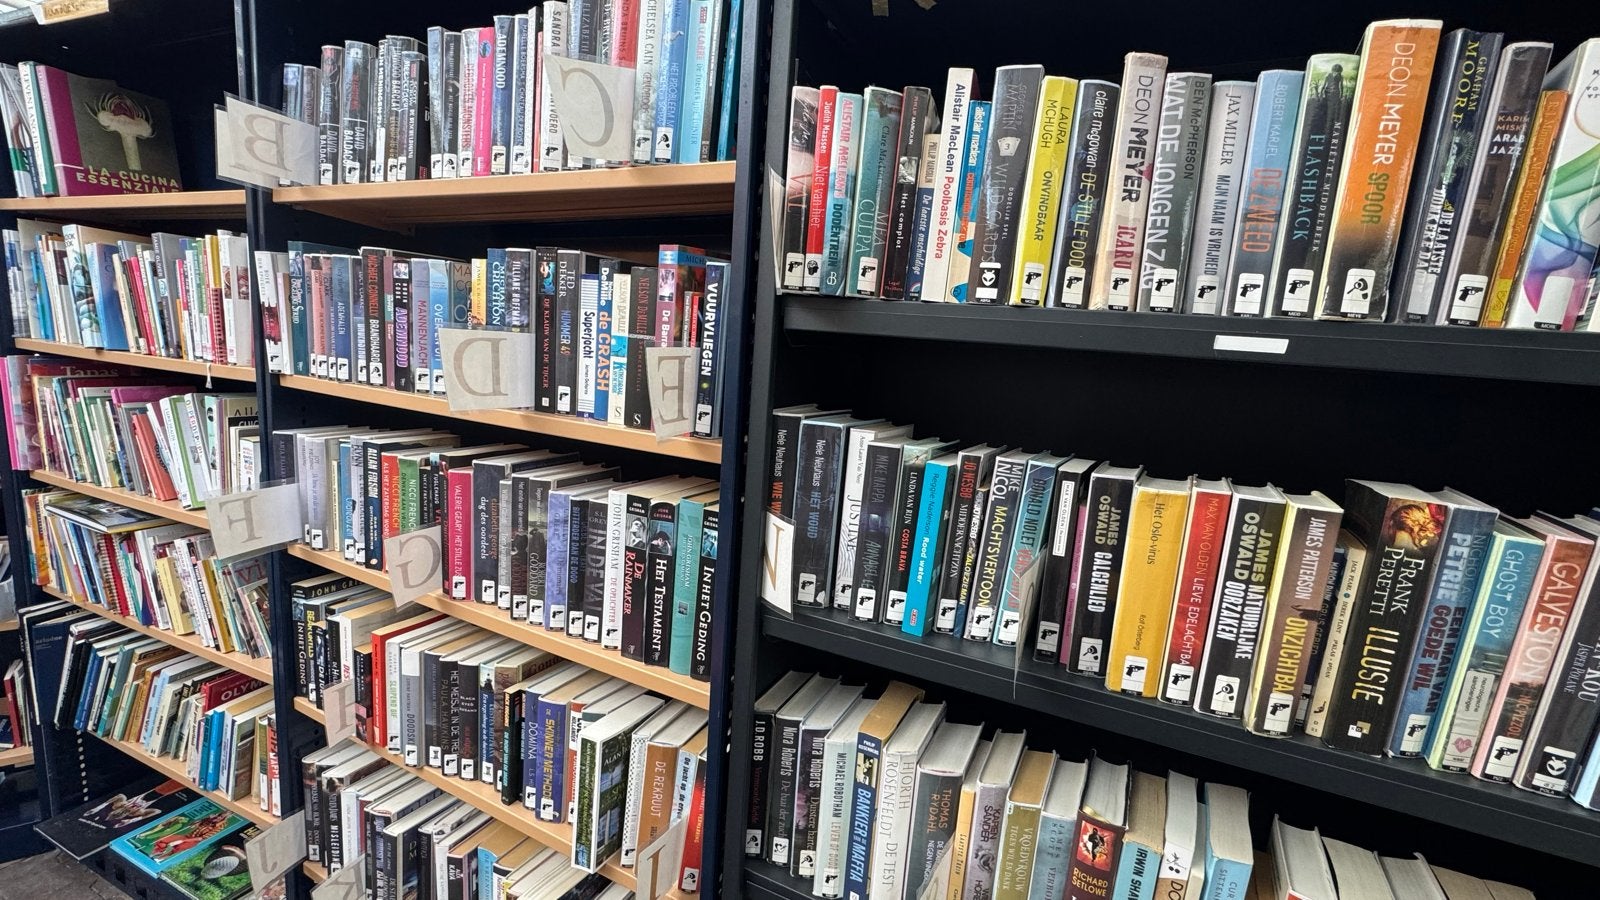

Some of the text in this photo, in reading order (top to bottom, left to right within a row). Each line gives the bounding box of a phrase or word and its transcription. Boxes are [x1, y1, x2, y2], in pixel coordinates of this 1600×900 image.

[552, 10, 561, 47] SANDRA
[496, 33, 508, 89] ADEMNOOD
[644, 43, 654, 65] CAIN
[391, 79, 400, 111] BARCLAY
[1191, 81, 1205, 107] BEN
[1451, 40, 1479, 129] MOORE
[1467, 56, 1488, 111] GRAHAM
[327, 129, 337, 153] DAVID
[354, 126, 364, 150] DAVID
[1040, 99, 1058, 149] MCHUGH
[1055, 106, 1070, 145] LAURA
[1121, 75, 1154, 204] DEON MEYER
[1360, 42, 1416, 226] DEON MEYER SPOOR
[1492, 134, 1525, 143] ARAB
[90, 165, 179, 187] LA CUCINA
[934, 83, 966, 259] Alistair MacLean Poolbasis Zebra
[1073, 91, 1107, 237] claire mcgowan STILLE
[1211, 93, 1241, 225] JAX MILLER MIJN NAAM
[1489, 146, 1523, 156] JAZZ
[816, 166, 828, 187] Niet
[1145, 127, 1181, 244] DE JONGEN
[1292, 134, 1326, 240] FLASHBACK
[1312, 121, 1342, 252] MARIETTE MIDDELBEEK
[855, 199, 875, 253] CULPA
[895, 193, 909, 249] Het complot
[1033, 170, 1053, 242] ONVINDBAAR
[827, 203, 843, 267] DODENTREIN
[367, 254, 378, 317] MICHAEL CONNELLY
[492, 262, 500, 325] CRICHTON
[559, 262, 567, 298] DEKKER
[567, 270, 575, 289] TED
[417, 300, 428, 368] MANNENJACHT
[561, 309, 571, 344] NUMMER
[581, 311, 595, 359] Superjacht
[662, 310, 670, 321] De
[701, 282, 718, 376] VUURVLIEGEN
[370, 319, 380, 363] BRANDHAARD
[597, 312, 612, 391] de CRASH
[368, 447, 378, 498] ALLAN FOLSOM
[774, 429, 787, 477] Nele Neuhaus
[454, 484, 462, 509] VALERIE
[479, 496, 489, 510] dag
[806, 439, 826, 540] Nele Neuhaus HET WOUD
[871, 454, 889, 504] MIKE NAPPA
[991, 461, 1011, 502] NICOL
[1007, 464, 1024, 493] MIKE
[1025, 478, 1046, 518] DONALD
[392, 498, 400, 528] FRENCH
[454, 511, 462, 530] GEARY
[898, 472, 918, 572] LINDA COSTA BRAVA
[917, 473, 940, 584] Reggie Rood water
[1020, 519, 1040, 548] NOLET
[1095, 495, 1111, 545] OSWALD
[1106, 506, 1122, 546] JAMES
[1147, 503, 1166, 565] Het Oslo-virus
[454, 547, 462, 565] STILLE
[480, 526, 489, 559] oordeels
[608, 503, 622, 624] JOHN GRISHAM DE OPLICHTER
[977, 505, 1008, 608] MACHTSVERTOON
[1190, 497, 1220, 604] MAX OLDEN LIEVE
[1234, 512, 1260, 581] OSWALD
[1249, 529, 1273, 583] JAMES
[1294, 517, 1328, 601] JAMES PATTERSON
[1436, 532, 1472, 601] PETRIE
[311, 584, 337, 598] JOHN
[529, 552, 539, 596] GODDARD
[623, 550, 636, 615] RAINMAKER
[634, 561, 645, 580] DE
[1088, 551, 1113, 613] GALGENLIED
[1369, 546, 1405, 616] PERETTI
[1389, 556, 1426, 616] FRANK
[1482, 549, 1524, 640] GHOST BOY
[652, 559, 668, 651] HET TESTAMENT
[1216, 580, 1246, 642] OORZAKEN
[1234, 584, 1266, 660] NATUURLIJKE
[1522, 561, 1581, 681] GALVESTON
[697, 612, 712, 661] GEDING
[1410, 604, 1451, 691] GOEDE WIL
[299, 651, 307, 684] GEDING
[1351, 626, 1400, 705] ILLUSIE
[440, 679, 449, 750] PAULA HAWKINS
[450, 670, 459, 714] HET MEISJE
[528, 721, 538, 760] DOMINA
[544, 719, 555, 758] SKINNER
[684, 757, 691, 766] De
[753, 737, 764, 761] ROBB
[780, 726, 798, 776] Nora Roberts
[650, 761, 666, 817] DE REKRUUT
[832, 752, 847, 818] MICHAEL ROBOTHAM
[879, 760, 898, 858] ROSENFELDT DE
[898, 761, 914, 809] HJORTH
[939, 789, 952, 829] THOMAS
[850, 787, 872, 883] BANKIER MAFFIA
[927, 793, 940, 834] RYDAHL
[980, 805, 993, 842] SANDER
[989, 808, 1001, 840] KAREN
[1015, 828, 1033, 892] VROEDVROUW
[1073, 868, 1108, 887] RICHARD
[1132, 847, 1148, 877] IRWIN
[1072, 876, 1107, 897] SETLOWE
